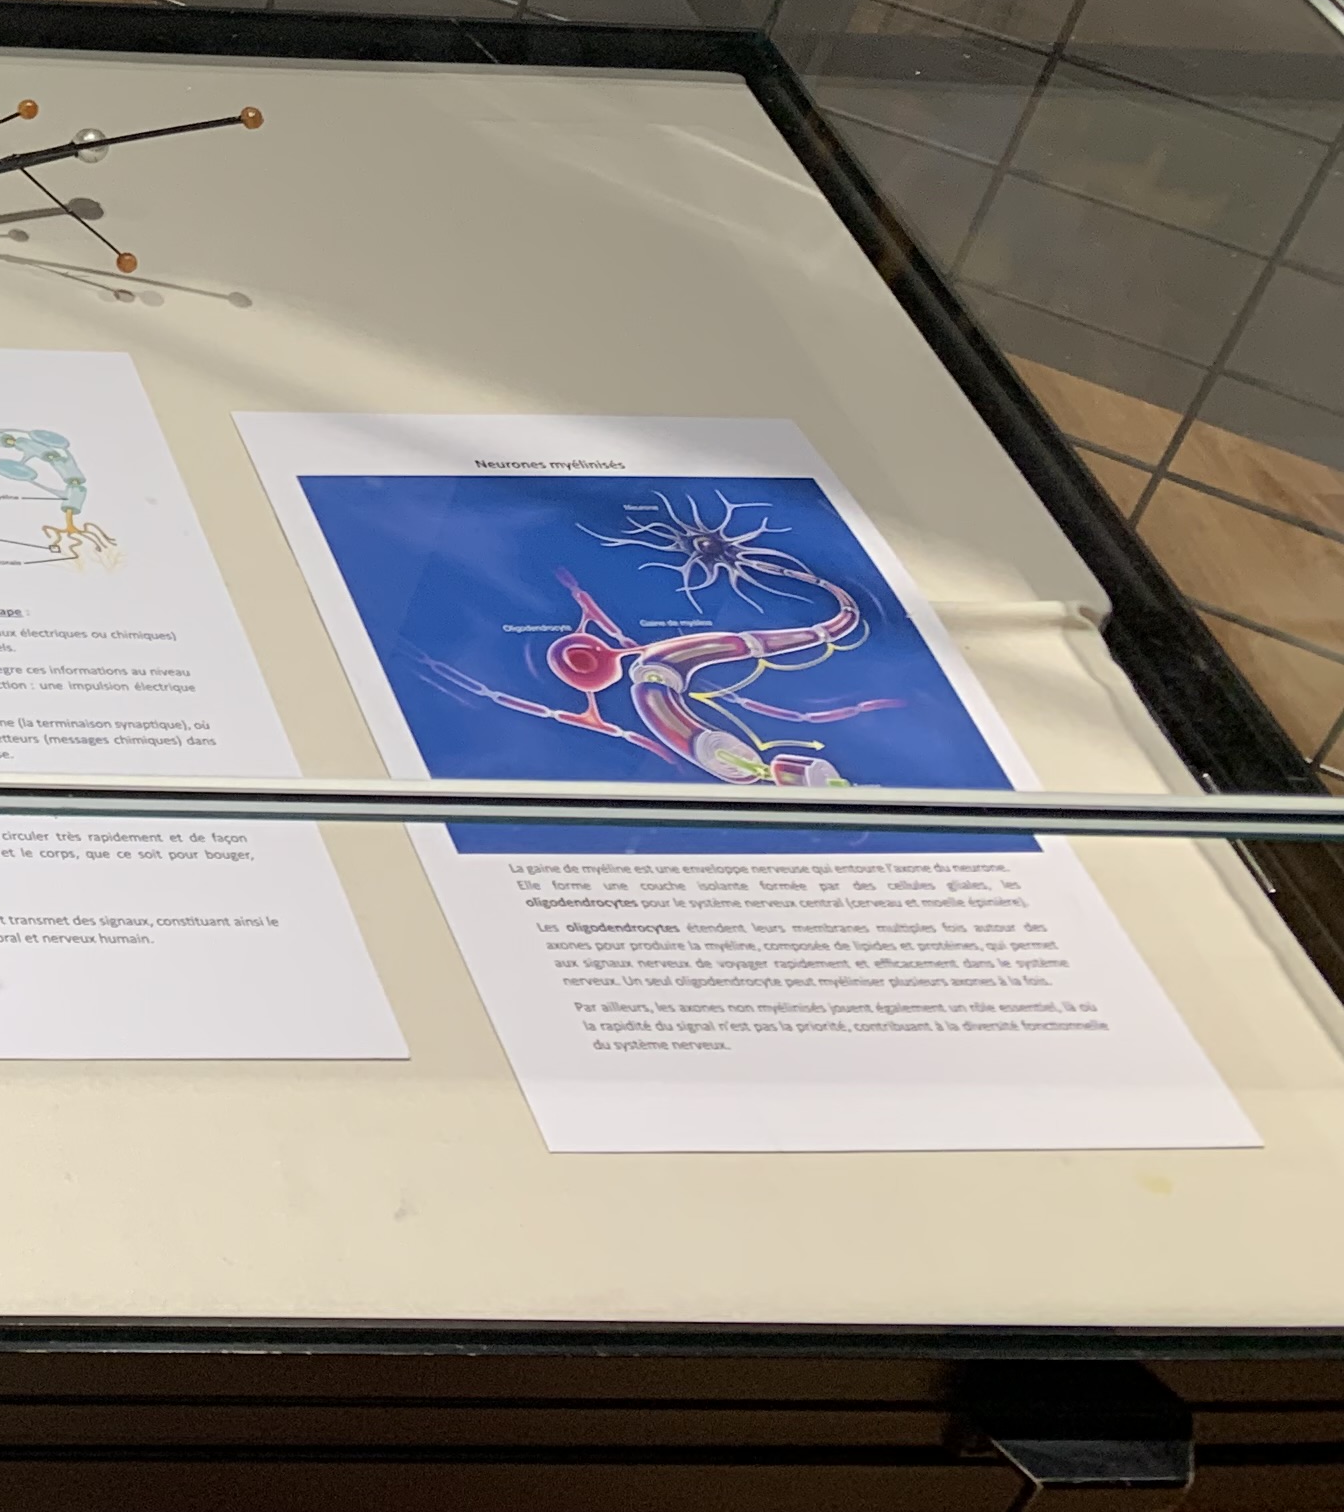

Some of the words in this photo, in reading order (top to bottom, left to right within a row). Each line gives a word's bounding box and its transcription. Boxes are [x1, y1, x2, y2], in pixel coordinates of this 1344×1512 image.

[475, 460, 546, 470] Neurones
[549, 460, 626, 472] myélinisés
[19, 628, 88, 640] électriques
[90, 631, 108, 639] ou
[110, 629, 177, 642] chimiques)
[1, 830, 49, 842] circuler
[55, 831, 82, 842] très
[87, 831, 163, 844] rapidement
[169, 833, 183, 843] et
[188, 832, 206, 843] de
[211, 832, 248, 845] façon
[7, 915, 70, 926] transmet
[71, 914, 97, 926] des
[98, 915, 154, 928] signaux,
[155, 916, 231, 927] constituant
[233, 916, 264, 927] ainsi
[265, 916, 279, 927] le
